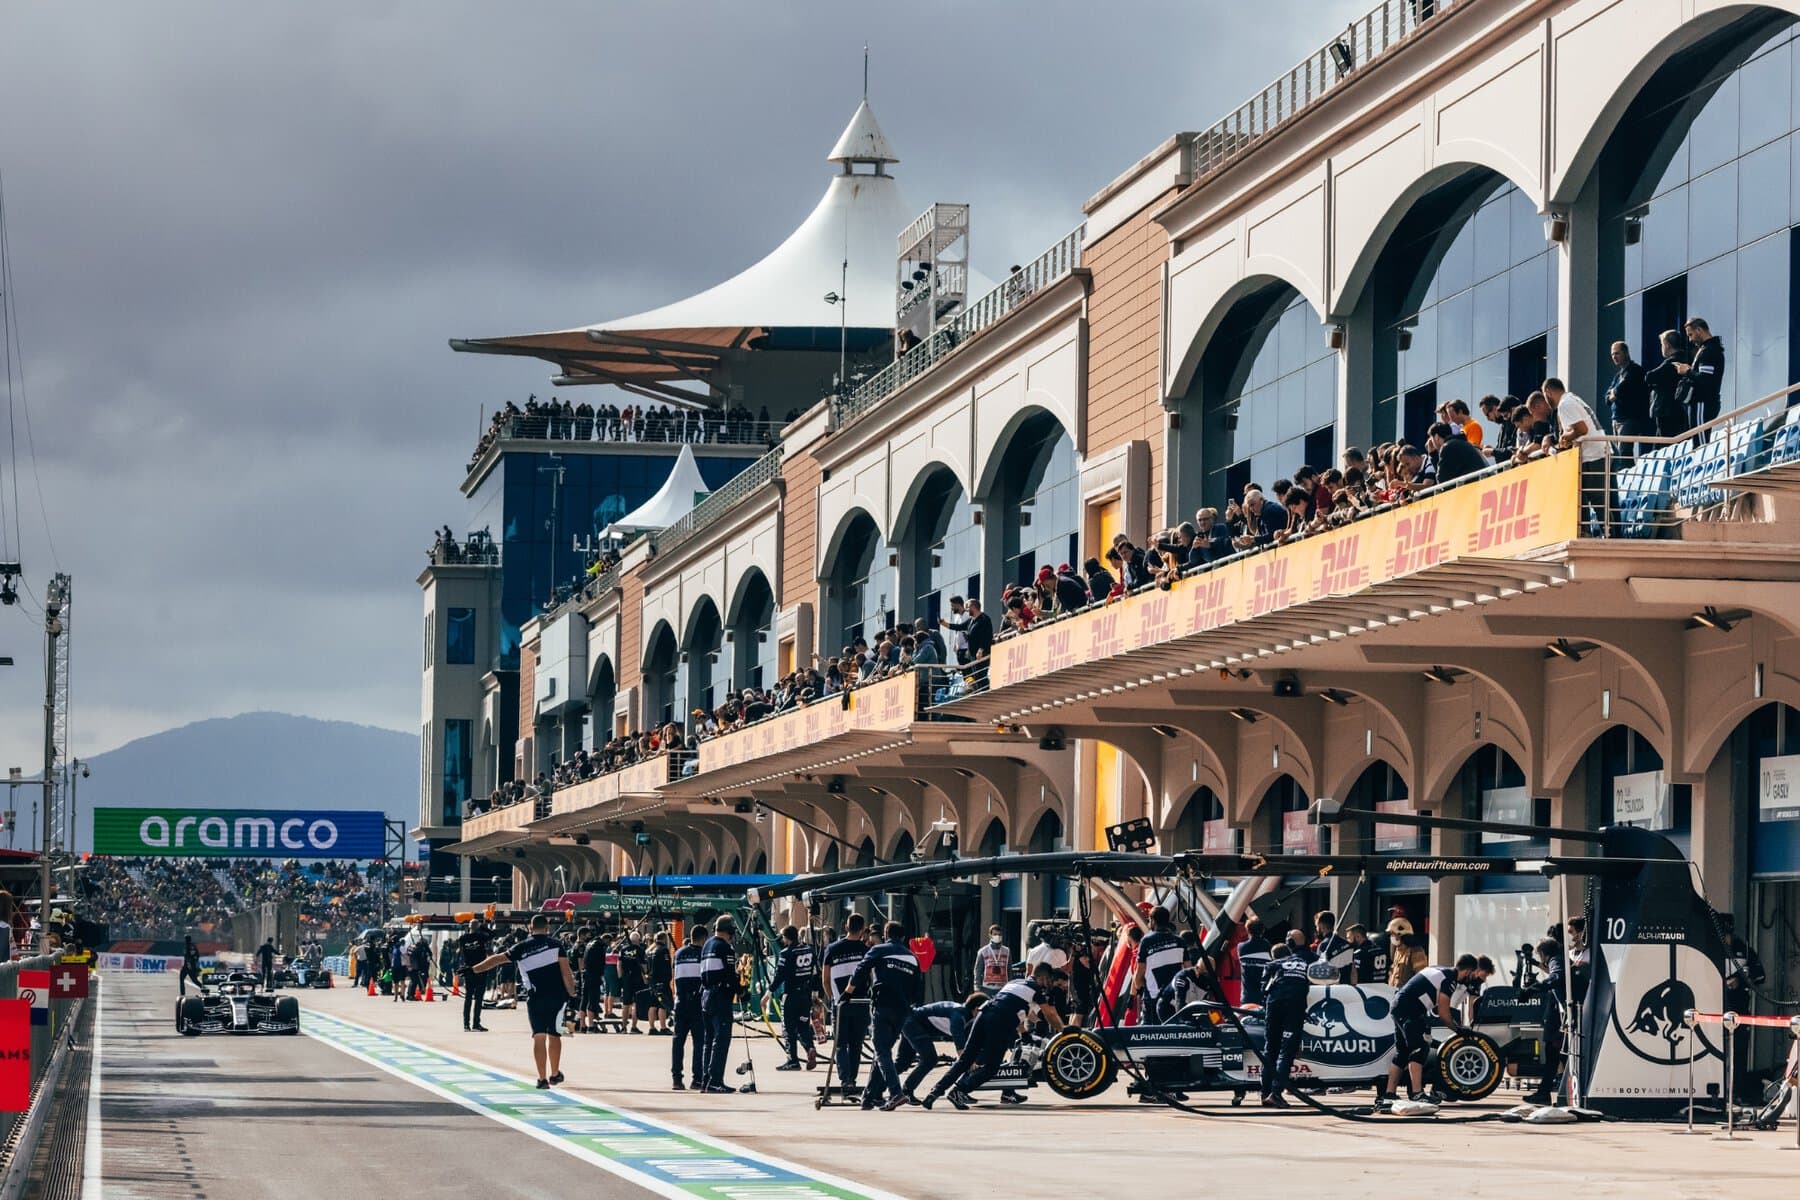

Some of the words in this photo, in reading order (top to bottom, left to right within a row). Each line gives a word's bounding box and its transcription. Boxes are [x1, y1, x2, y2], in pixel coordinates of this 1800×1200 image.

[1477, 479, 1531, 550] DHL
[1394, 508, 1441, 577] DHL
[1252, 557, 1290, 616] DHL
[1319, 534, 1362, 597] DHL
[1140, 596, 1170, 645] DHL
[1193, 577, 1227, 631] DHL
[1047, 629, 1072, 671] DHL
[1090, 613, 1120, 658] DHL
[139, 815, 338, 850] aramco
[1606, 917, 1626, 940] 10
[1637, 932, 1685, 940] ALPHATAURI
[1130, 1031, 1212, 1041] ALPHATAURI.FASHION
[1301, 1039, 1376, 1053] HATAURI
[1247, 1065, 1313, 1074] HDA
